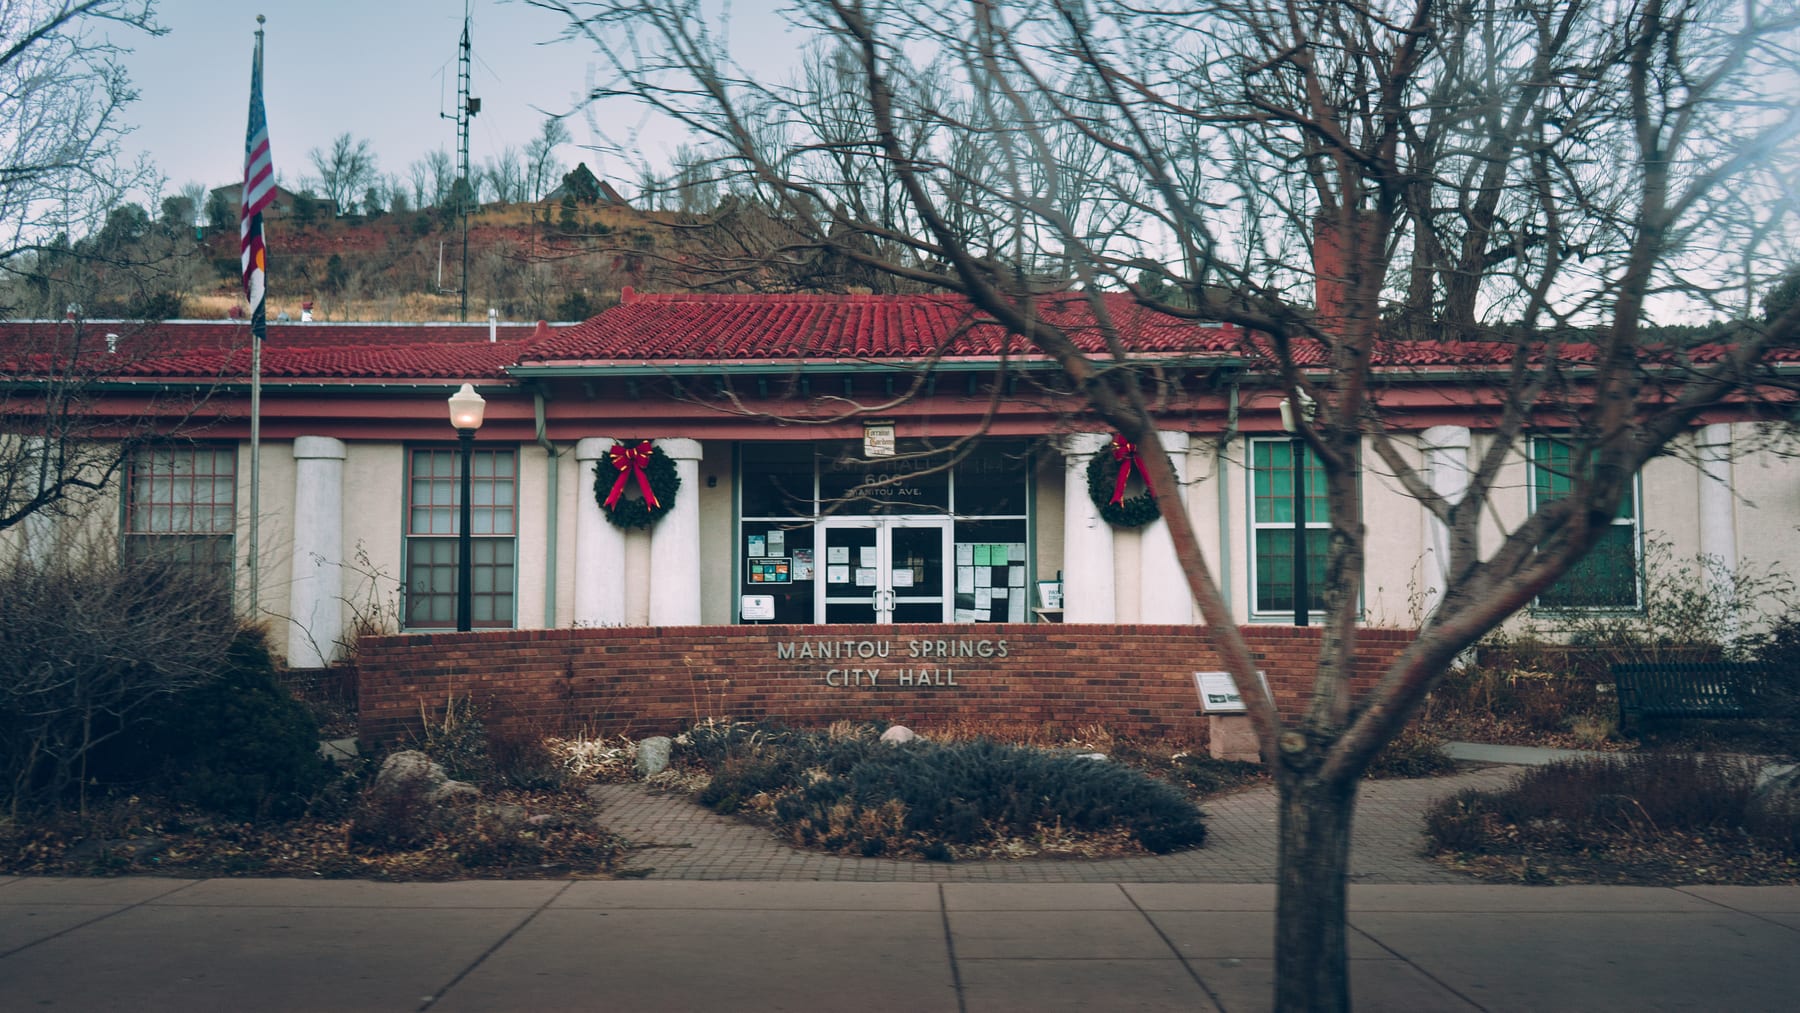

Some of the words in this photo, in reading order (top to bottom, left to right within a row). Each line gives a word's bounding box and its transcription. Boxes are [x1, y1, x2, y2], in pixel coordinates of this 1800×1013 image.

[898, 488, 922, 496] AVE.
[777, 640, 890, 659] MANITOU
[909, 639, 1009, 658] SPRINGS
[826, 668, 881, 687] CITY
[899, 668, 958, 687] HALL
